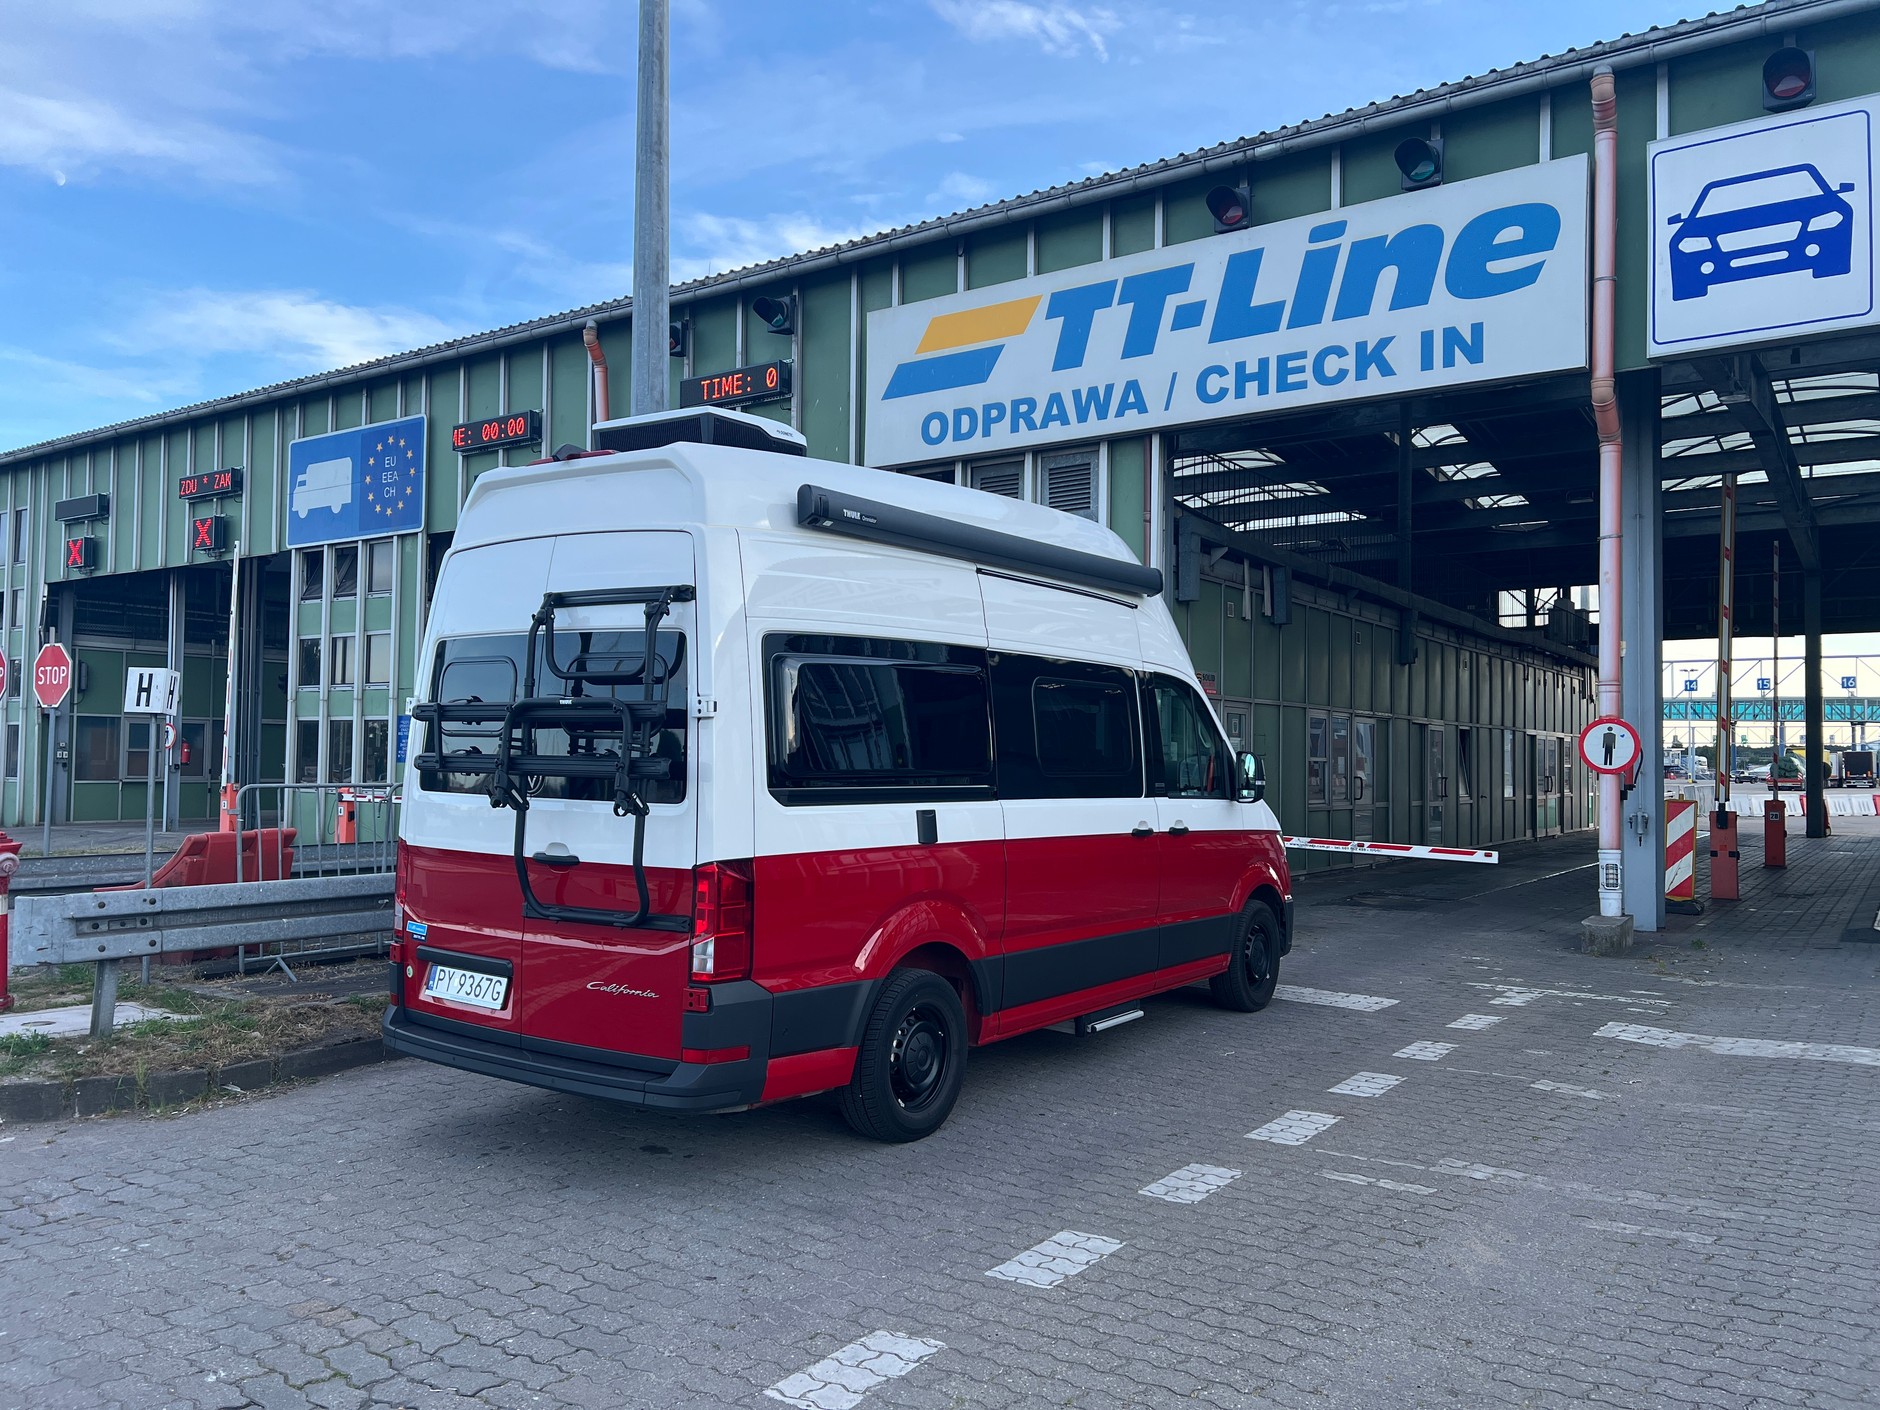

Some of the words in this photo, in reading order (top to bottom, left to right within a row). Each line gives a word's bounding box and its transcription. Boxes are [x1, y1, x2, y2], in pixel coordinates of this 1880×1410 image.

[1046, 202, 1561, 372] TT-Line
[701, 373, 752, 400] TIME:
[920, 378, 1149, 446] ODPRAWA
[1196, 335, 1399, 405] CHECK
[1420, 321, 1485, 373] IN
[482, 417, 525, 441] 00:00
[384, 456, 397, 468] EU
[382, 471, 399, 483] EEA
[384, 487, 396, 498] CH
[38, 666, 67, 685] STOP
[1758, 679, 1770, 689] 15
[1842, 677, 1855, 688] 16
[135, 673, 154, 707] H
[166, 675, 178, 709] H
[1685, 681, 1697, 690] 14
[435, 968, 456, 992] PY
[456, 973, 503, 1001] 9367G
[586, 981, 660, 998] California
